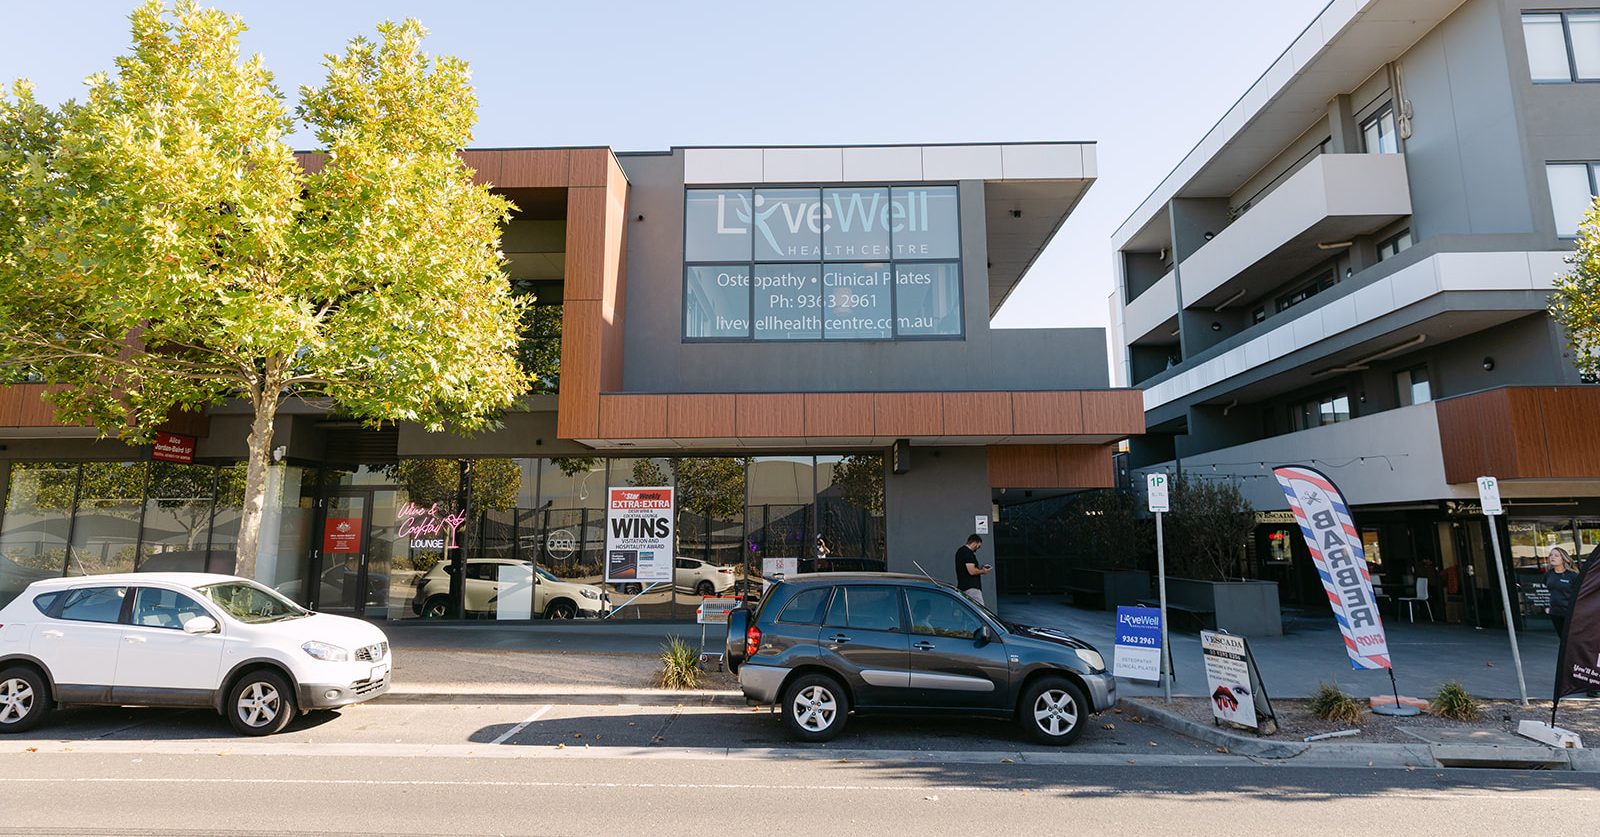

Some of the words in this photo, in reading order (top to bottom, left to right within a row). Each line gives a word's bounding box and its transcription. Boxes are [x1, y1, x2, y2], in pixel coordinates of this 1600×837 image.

[788, 245, 855, 256] HEALTH
[717, 272, 806, 290] Osteopathy
[824, 271, 878, 286] Clinical
[883, 271, 932, 285] Plates
[770, 294, 793, 308] Ph:
[798, 294, 836, 308] 9363
[841, 294, 876, 308] 2961
[1151, 477, 1164, 487] 1P
[1481, 480, 1494, 490] 1P
[398, 502, 426, 518] Wine
[428, 503, 438, 515] &
[398, 516, 446, 539] Cocktail
[611, 518, 670, 538] WINS
[410, 539, 444, 549] LOUNGE
[548, 539, 574, 550] OPEN
[1120, 614, 1159, 626] LiveWell
[1122, 635, 1138, 644] 9363
[1139, 636, 1155, 645] 2961
[1204, 634, 1242, 648] VESCADA
